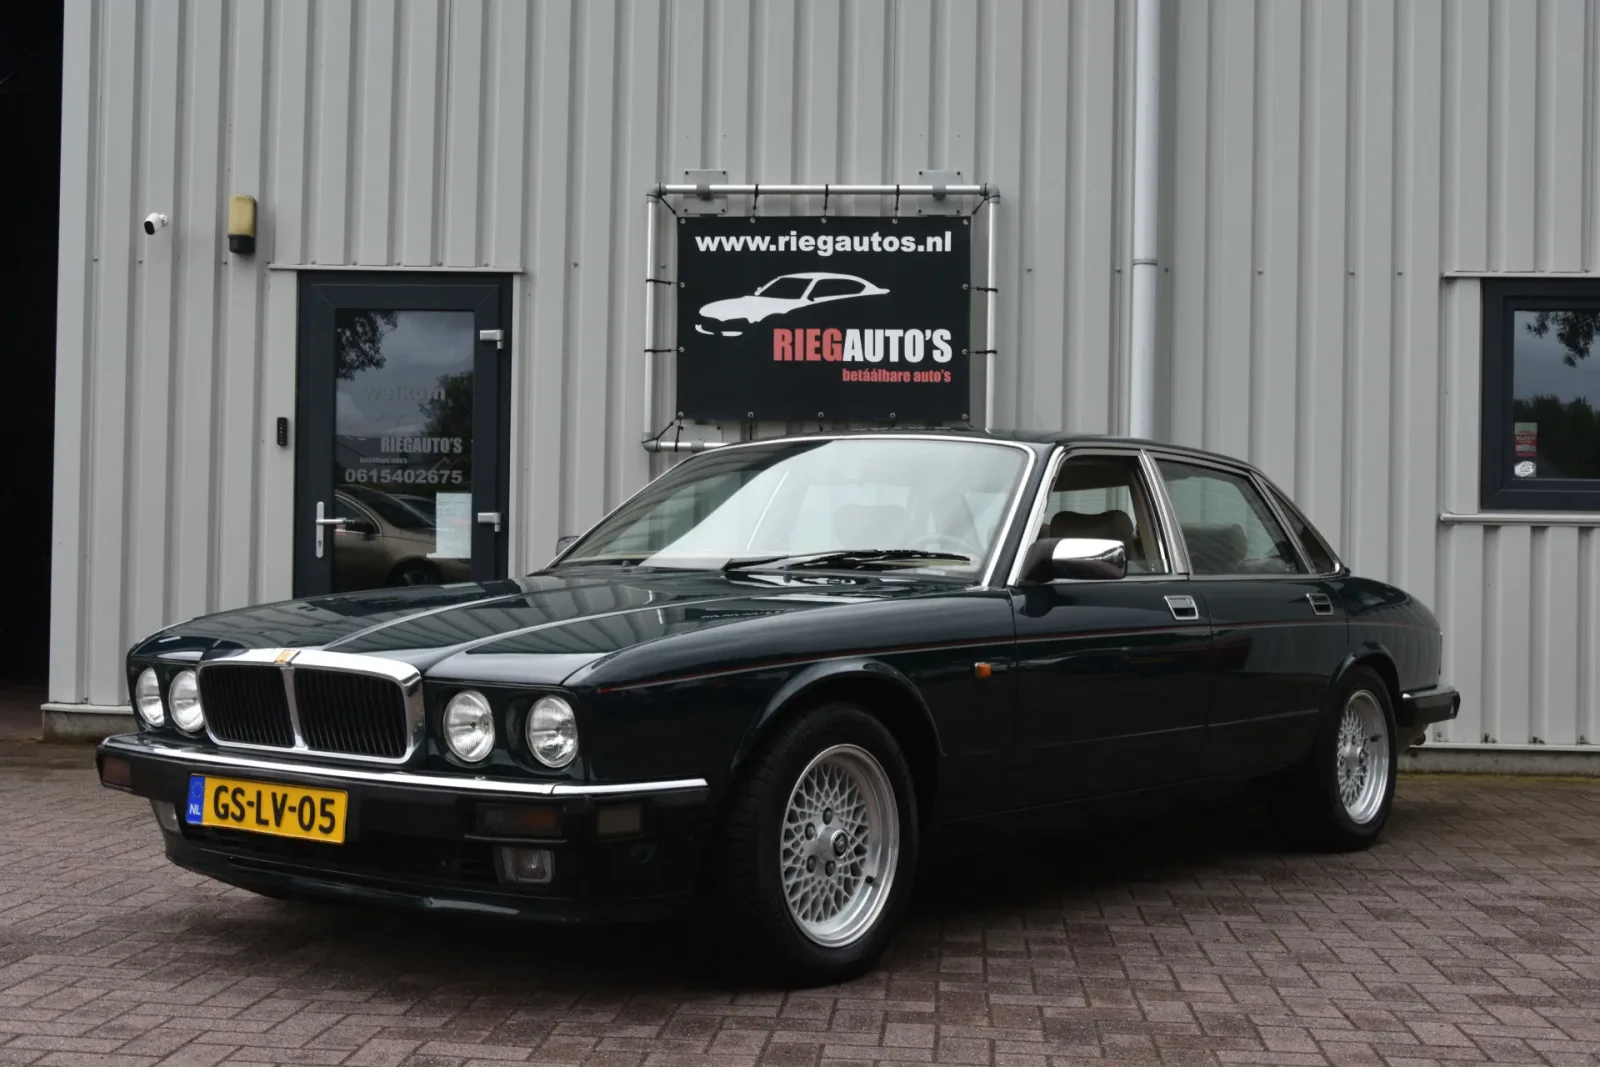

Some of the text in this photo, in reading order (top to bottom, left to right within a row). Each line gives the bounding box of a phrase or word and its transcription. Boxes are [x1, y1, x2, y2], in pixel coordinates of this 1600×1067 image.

[695, 230, 952, 256] www.riegautos.nl
[773, 328, 953, 363] RIEGAUTO'S
[842, 368, 952, 383] betáálbare auto's
[363, 383, 446, 401] welkom
[380, 437, 463, 454] RIEGAUTO'S
[344, 468, 463, 484] 0615402675
[189, 804, 201, 816] NL
[213, 785, 336, 834] GS-LV-05
